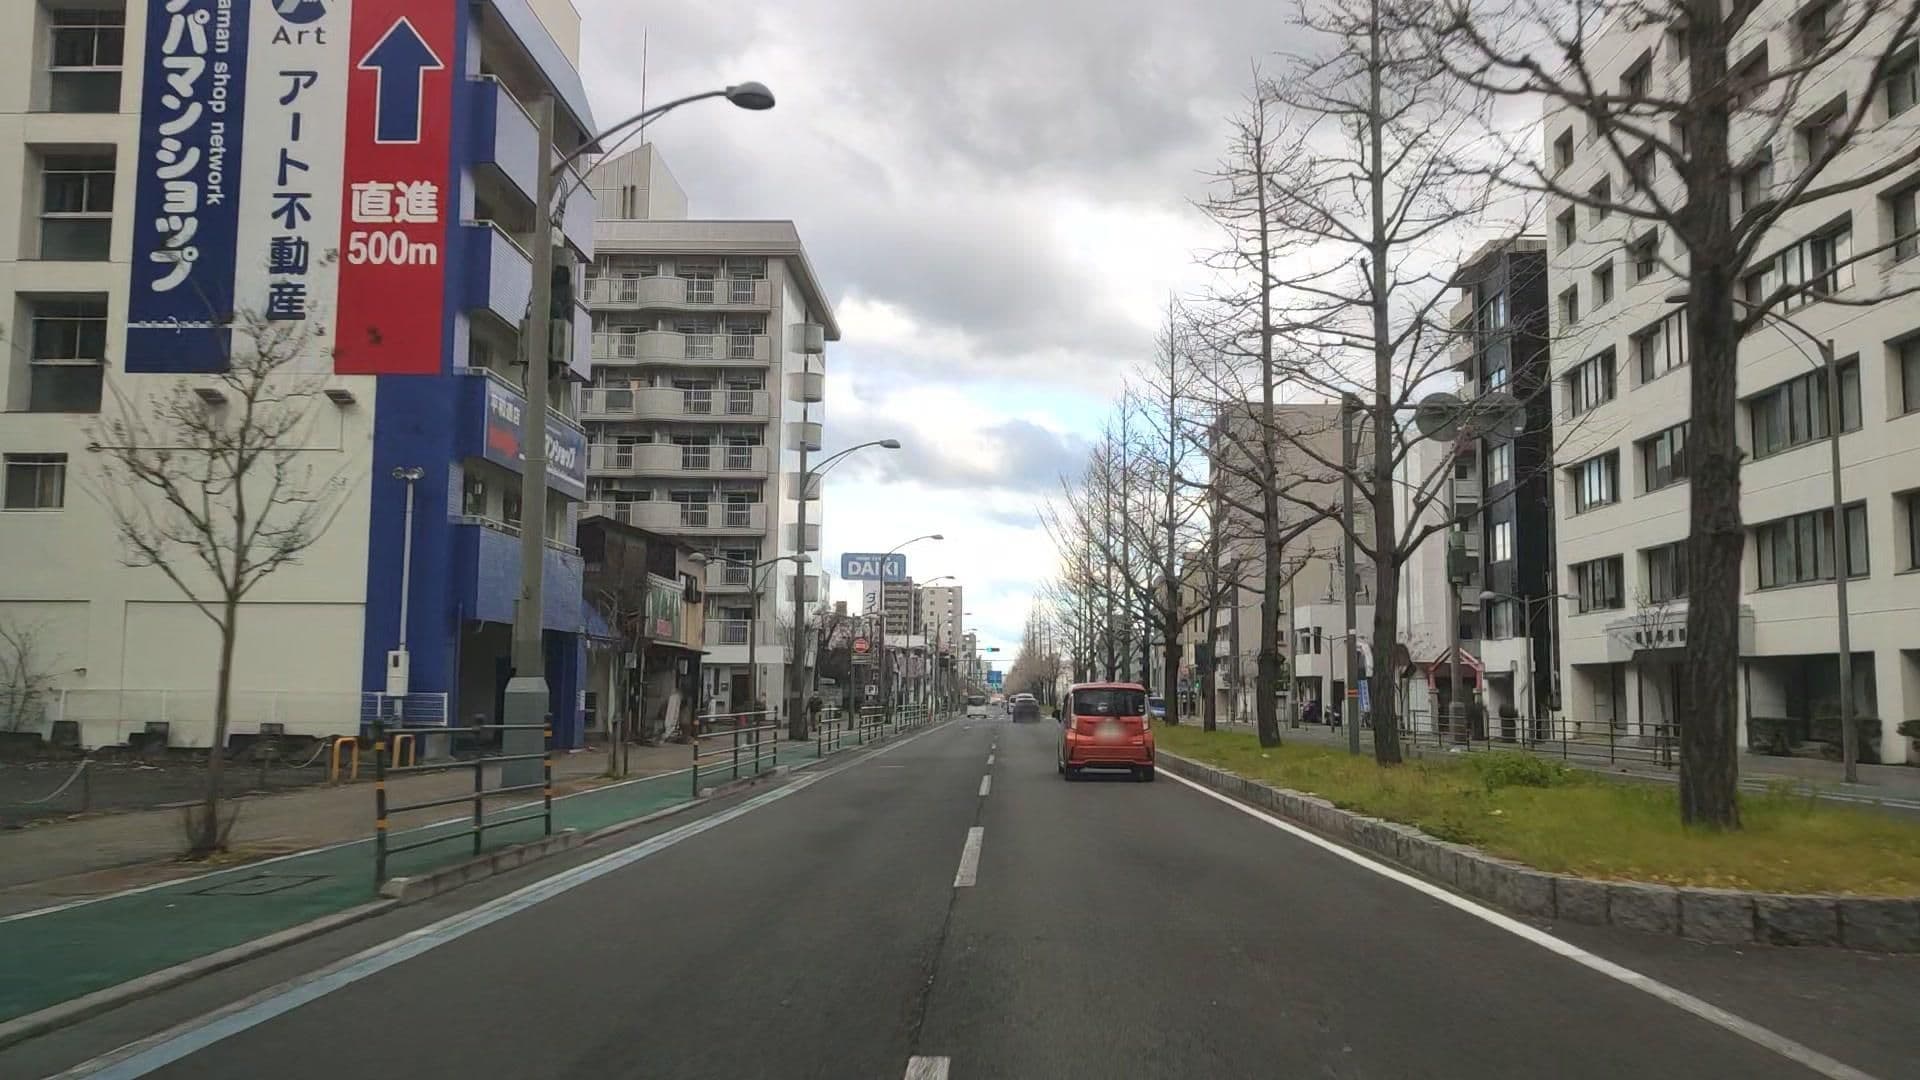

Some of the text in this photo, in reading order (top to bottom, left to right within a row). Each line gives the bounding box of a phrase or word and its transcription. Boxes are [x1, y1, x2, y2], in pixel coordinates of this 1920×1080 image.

[272, 26, 327, 45] Art
[208, 62, 231, 113] shop
[206, 121, 227, 205] network
[266, 71, 318, 320] アート不動産
[351, 180, 438, 223] 直進
[347, 230, 438, 265] 500m
